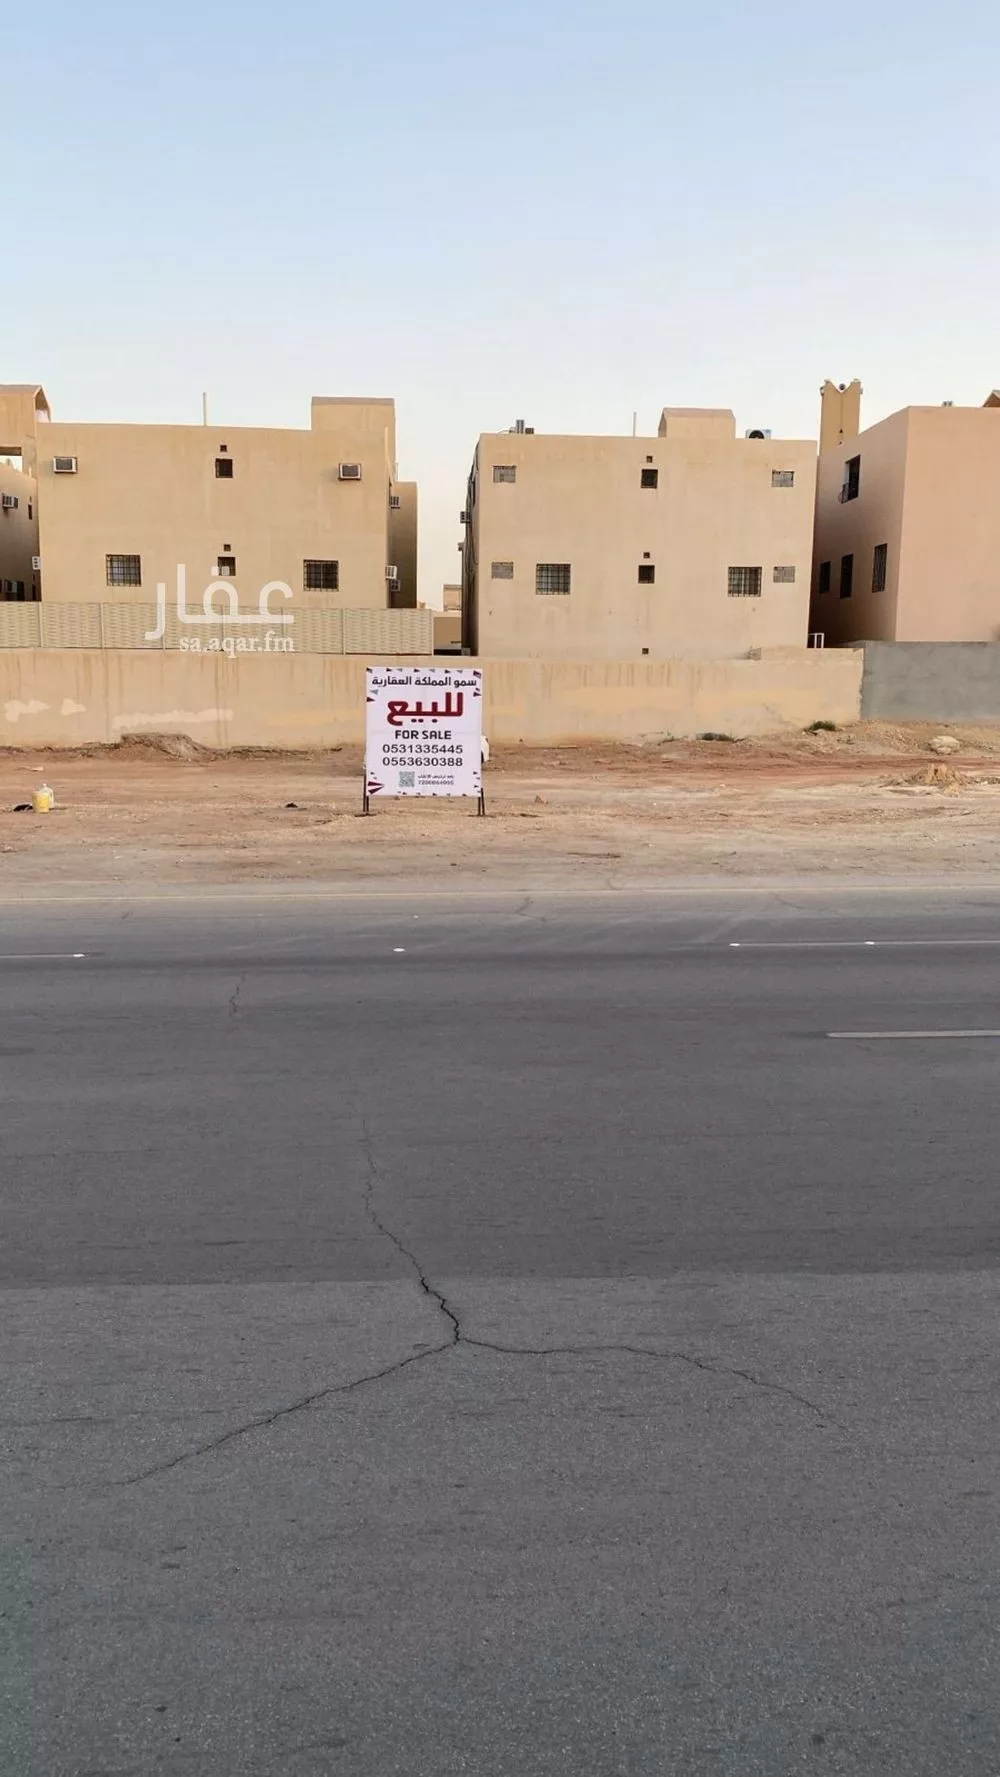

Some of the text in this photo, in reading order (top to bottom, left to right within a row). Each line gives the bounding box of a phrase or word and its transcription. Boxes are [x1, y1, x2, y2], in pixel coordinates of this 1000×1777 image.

[372, 676, 477, 688] سمو المملكة العقارية
[387, 692, 463, 726] للبيع
[395, 730, 452, 740] FOR SALE
[382, 744, 463, 754] 0531335445
[382, 757, 463, 767] 0553630388
